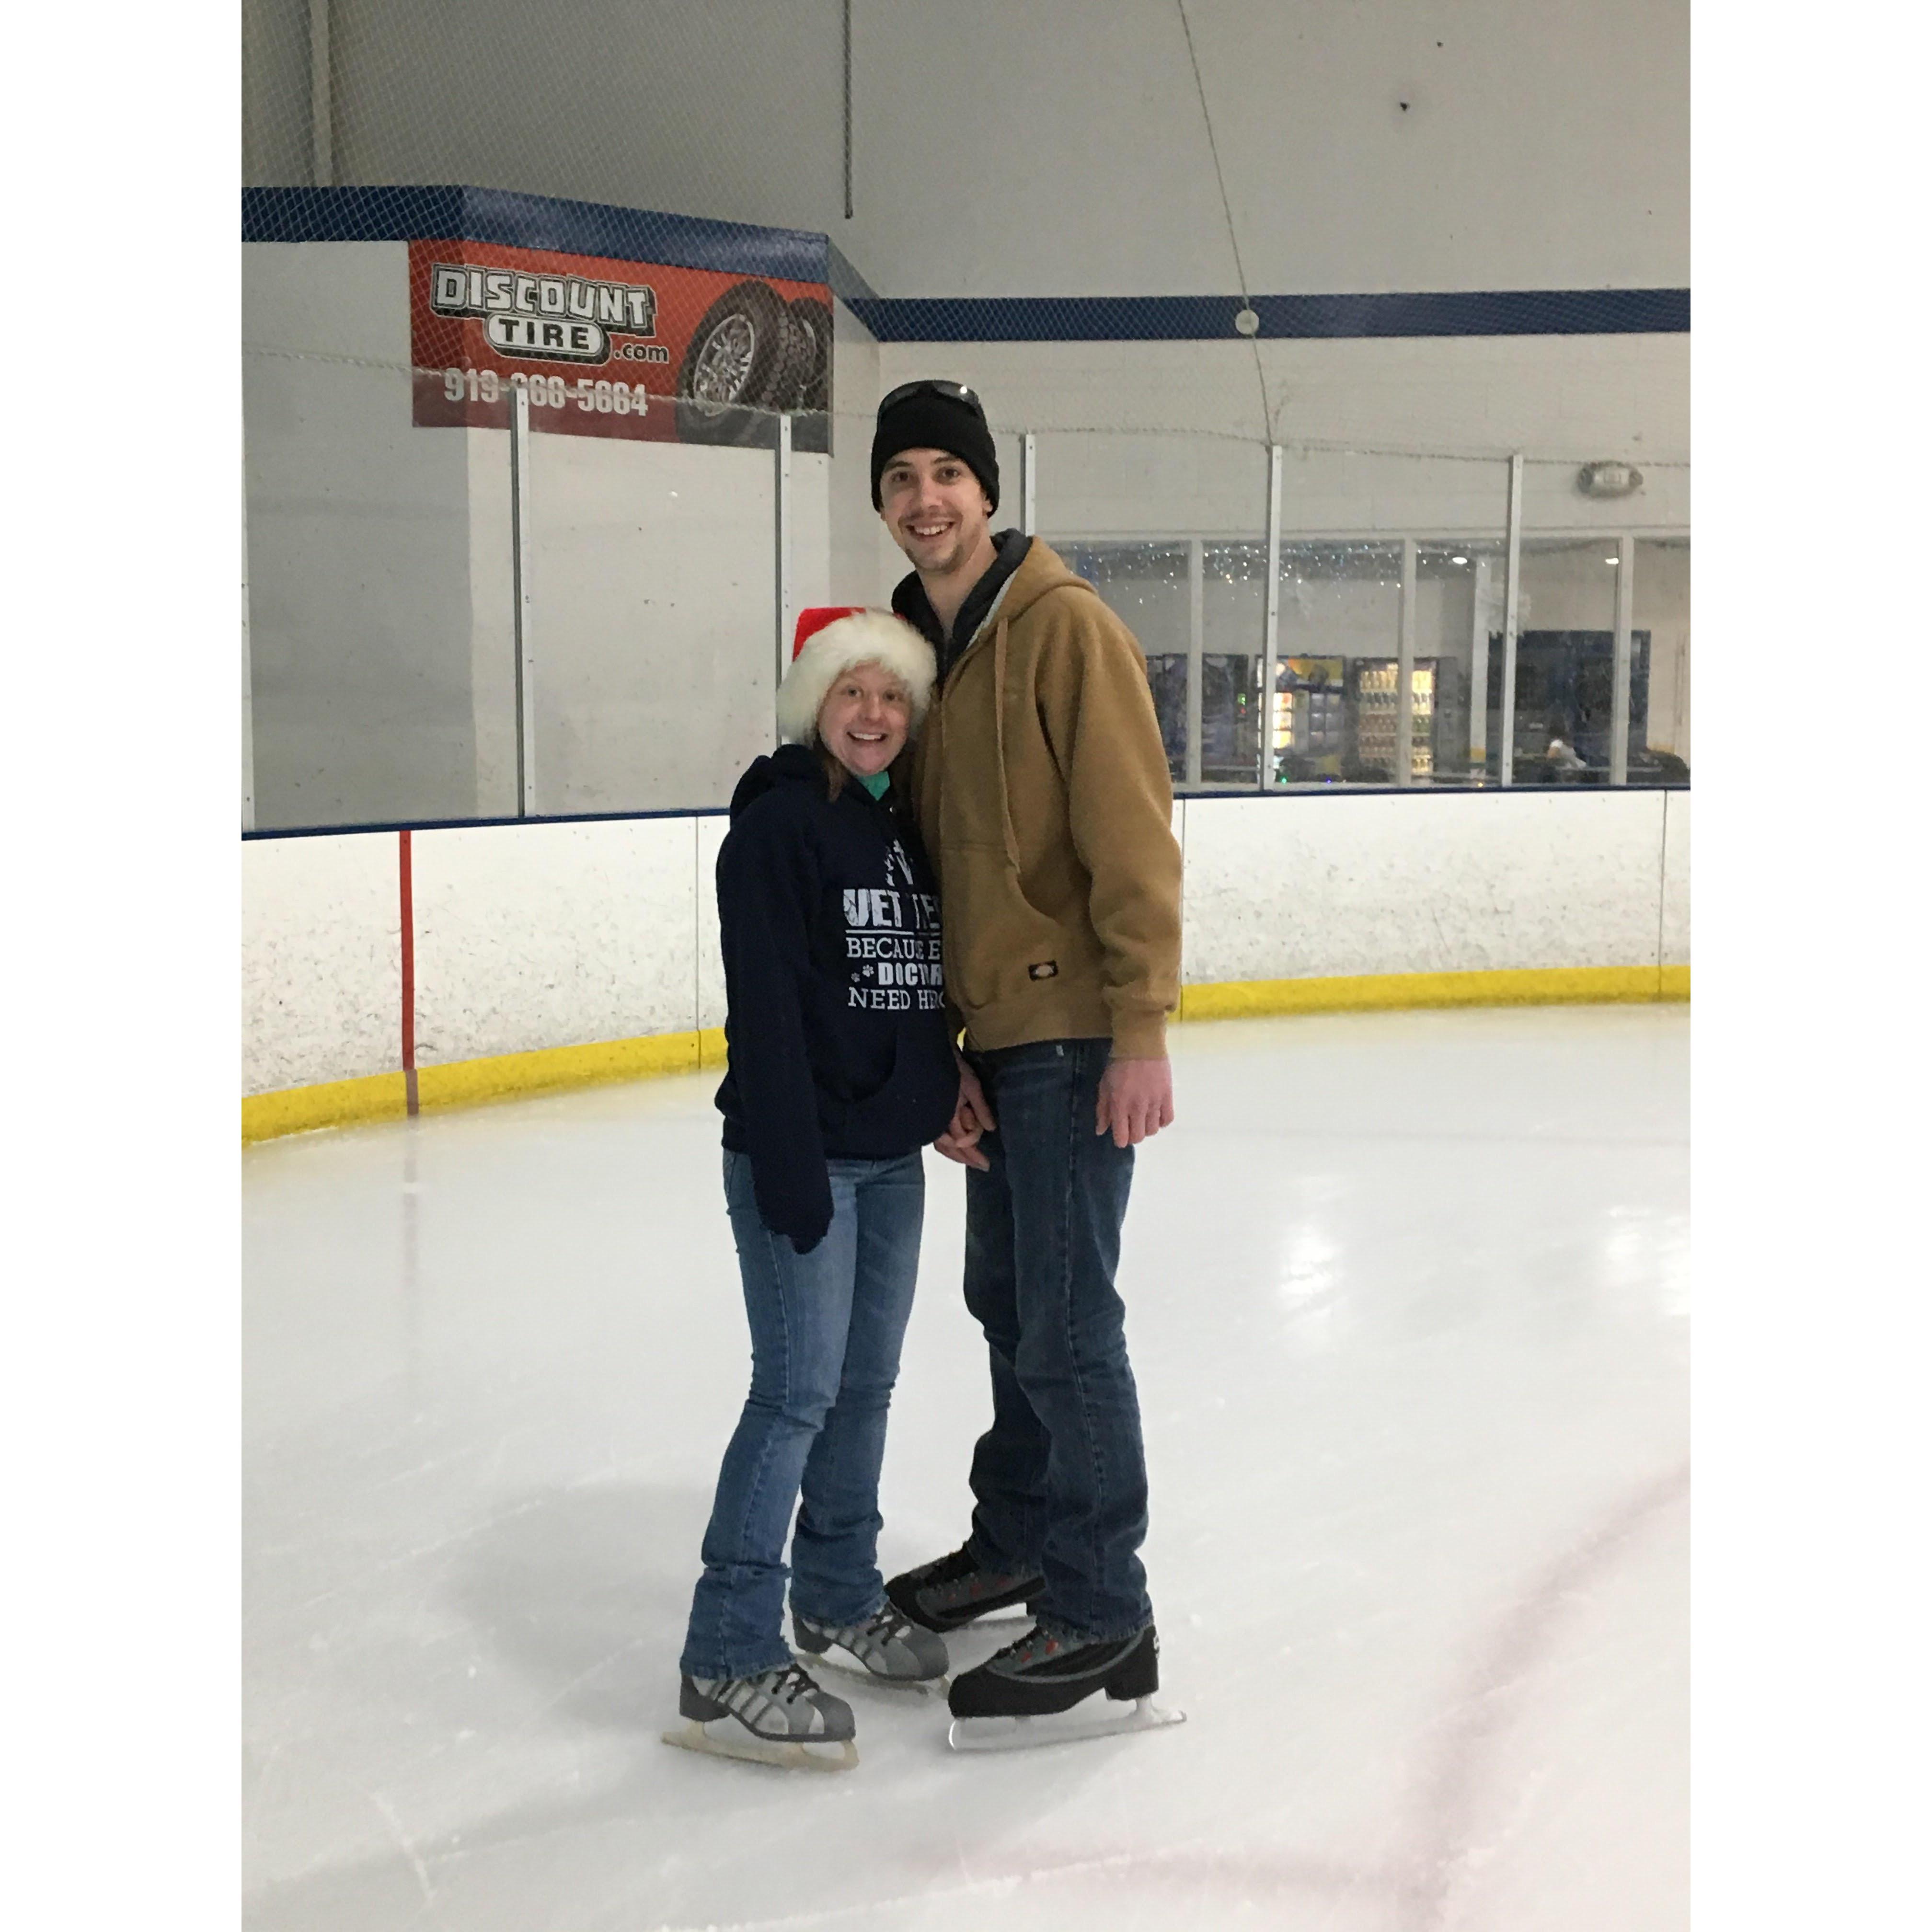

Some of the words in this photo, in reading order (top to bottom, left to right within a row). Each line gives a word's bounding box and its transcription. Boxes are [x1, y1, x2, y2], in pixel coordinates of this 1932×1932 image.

[433, 265, 652, 328] DISCOUNT
[498, 318, 590, 351] TIRE
[613, 343, 669, 364] .com
[843, 888, 902, 928] VET
[848, 987, 910, 1010] NEED
